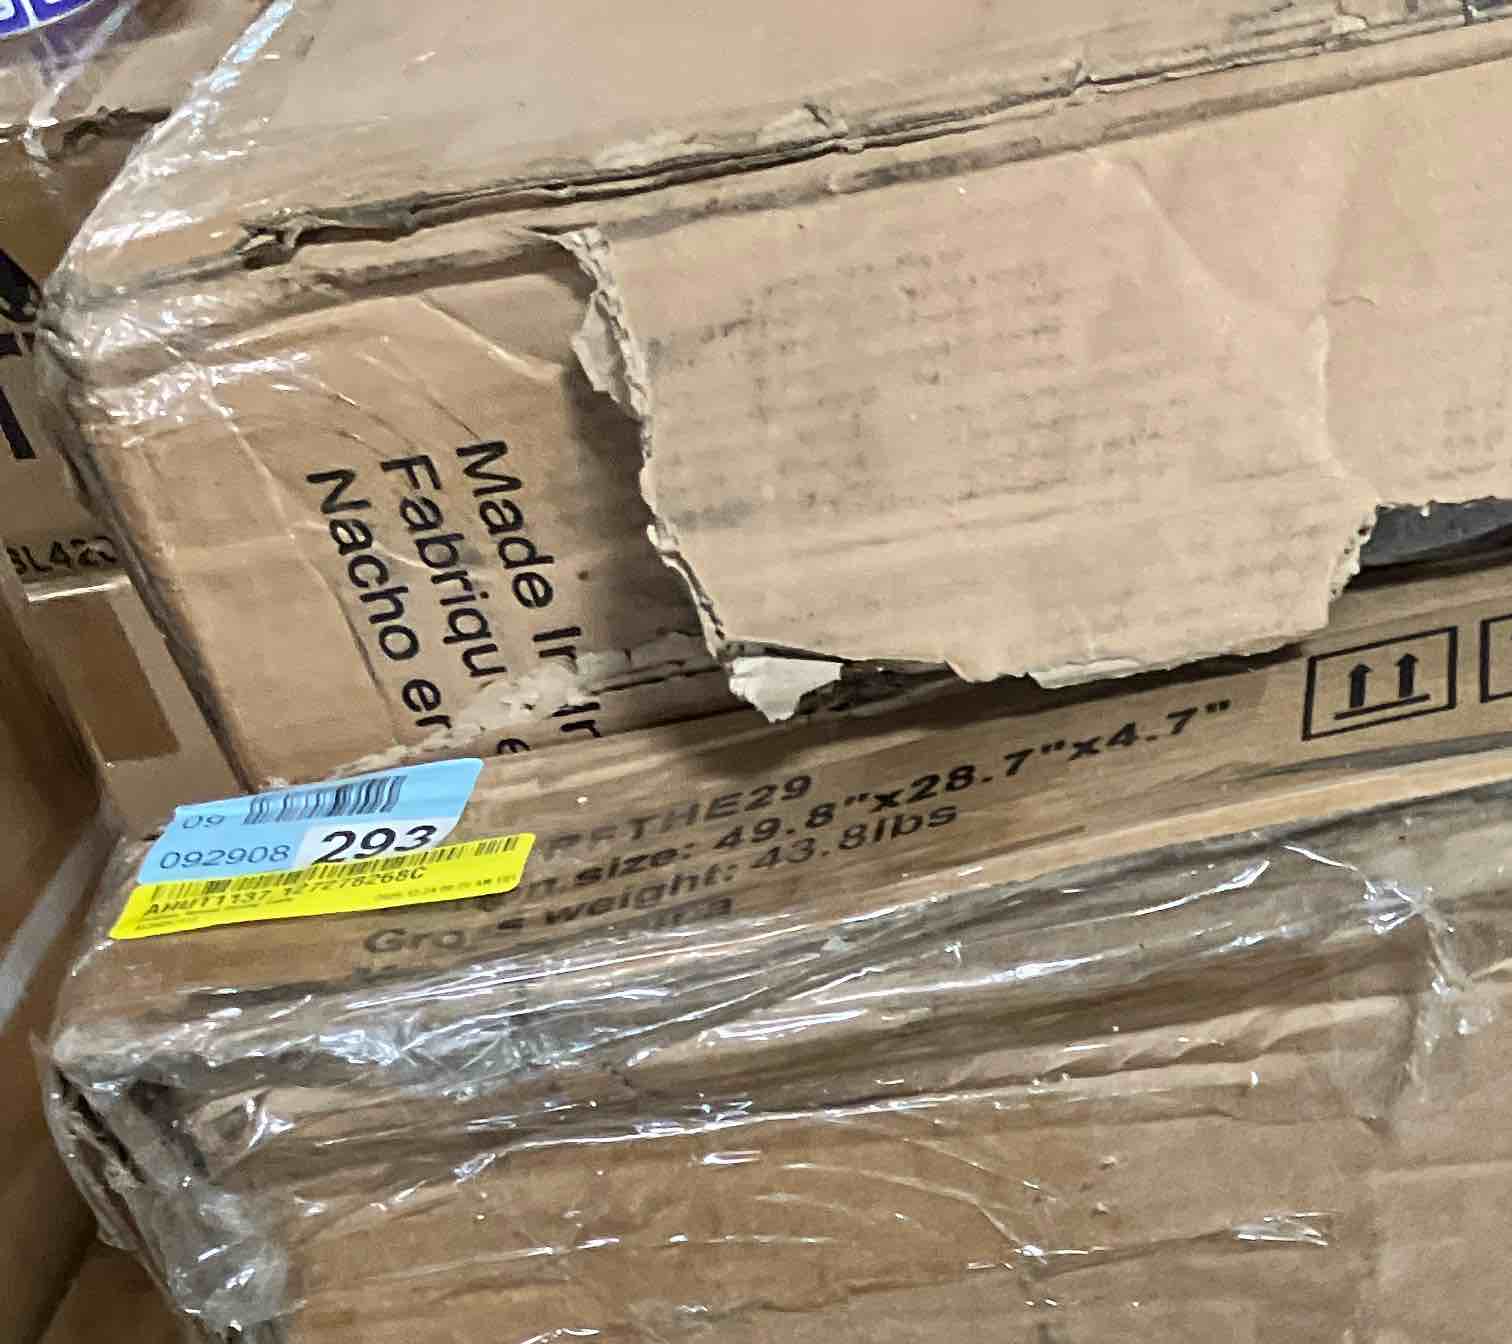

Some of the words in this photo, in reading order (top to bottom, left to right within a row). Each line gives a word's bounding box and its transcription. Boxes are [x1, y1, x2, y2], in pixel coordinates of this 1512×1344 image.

[306, 469, 420, 661] Nacho
[456, 440, 554, 608] Made
[159, 843, 291, 870] 092908
[313, 824, 438, 865] 293
